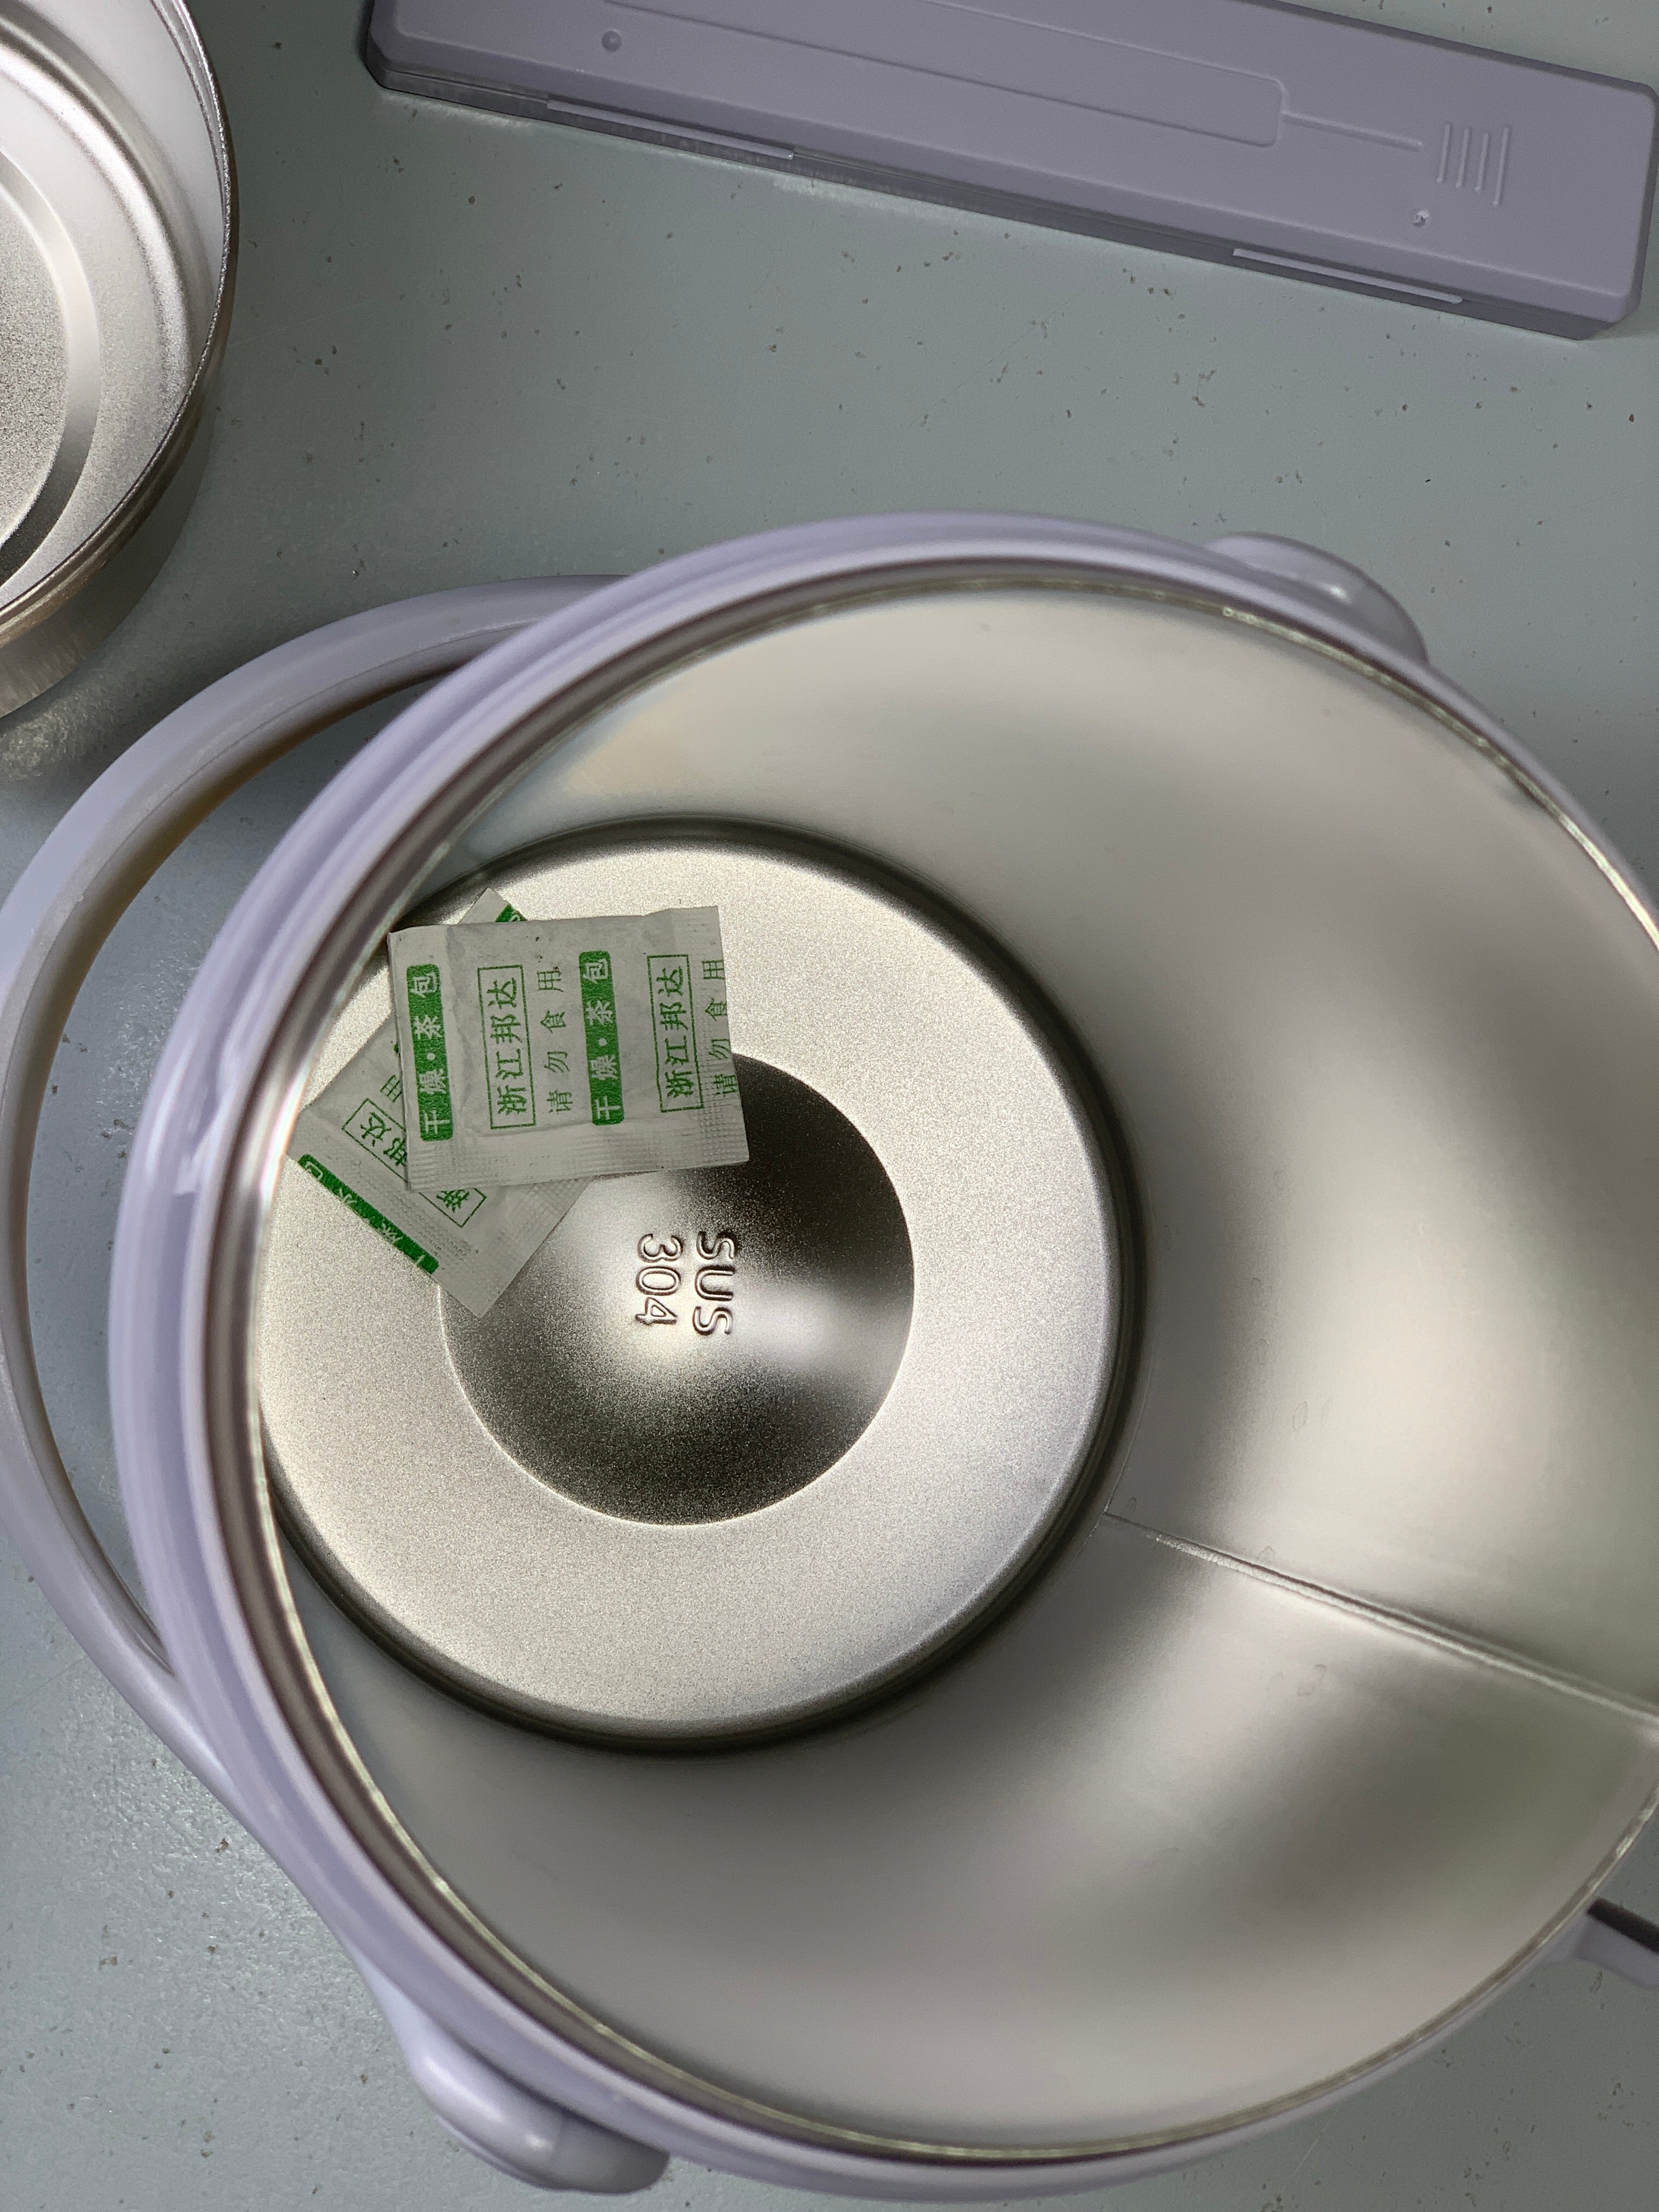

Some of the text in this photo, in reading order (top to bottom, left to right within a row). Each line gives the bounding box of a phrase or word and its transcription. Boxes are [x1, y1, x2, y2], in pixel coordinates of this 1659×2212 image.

[487, 977, 528, 1115] 浙江邦达
[536, 969, 573, 1114] 请勿食用
[657, 966, 694, 1098] 浙江邦达
[635, 1233, 684, 1327] 304
[692, 1231, 738, 1336] SUS
